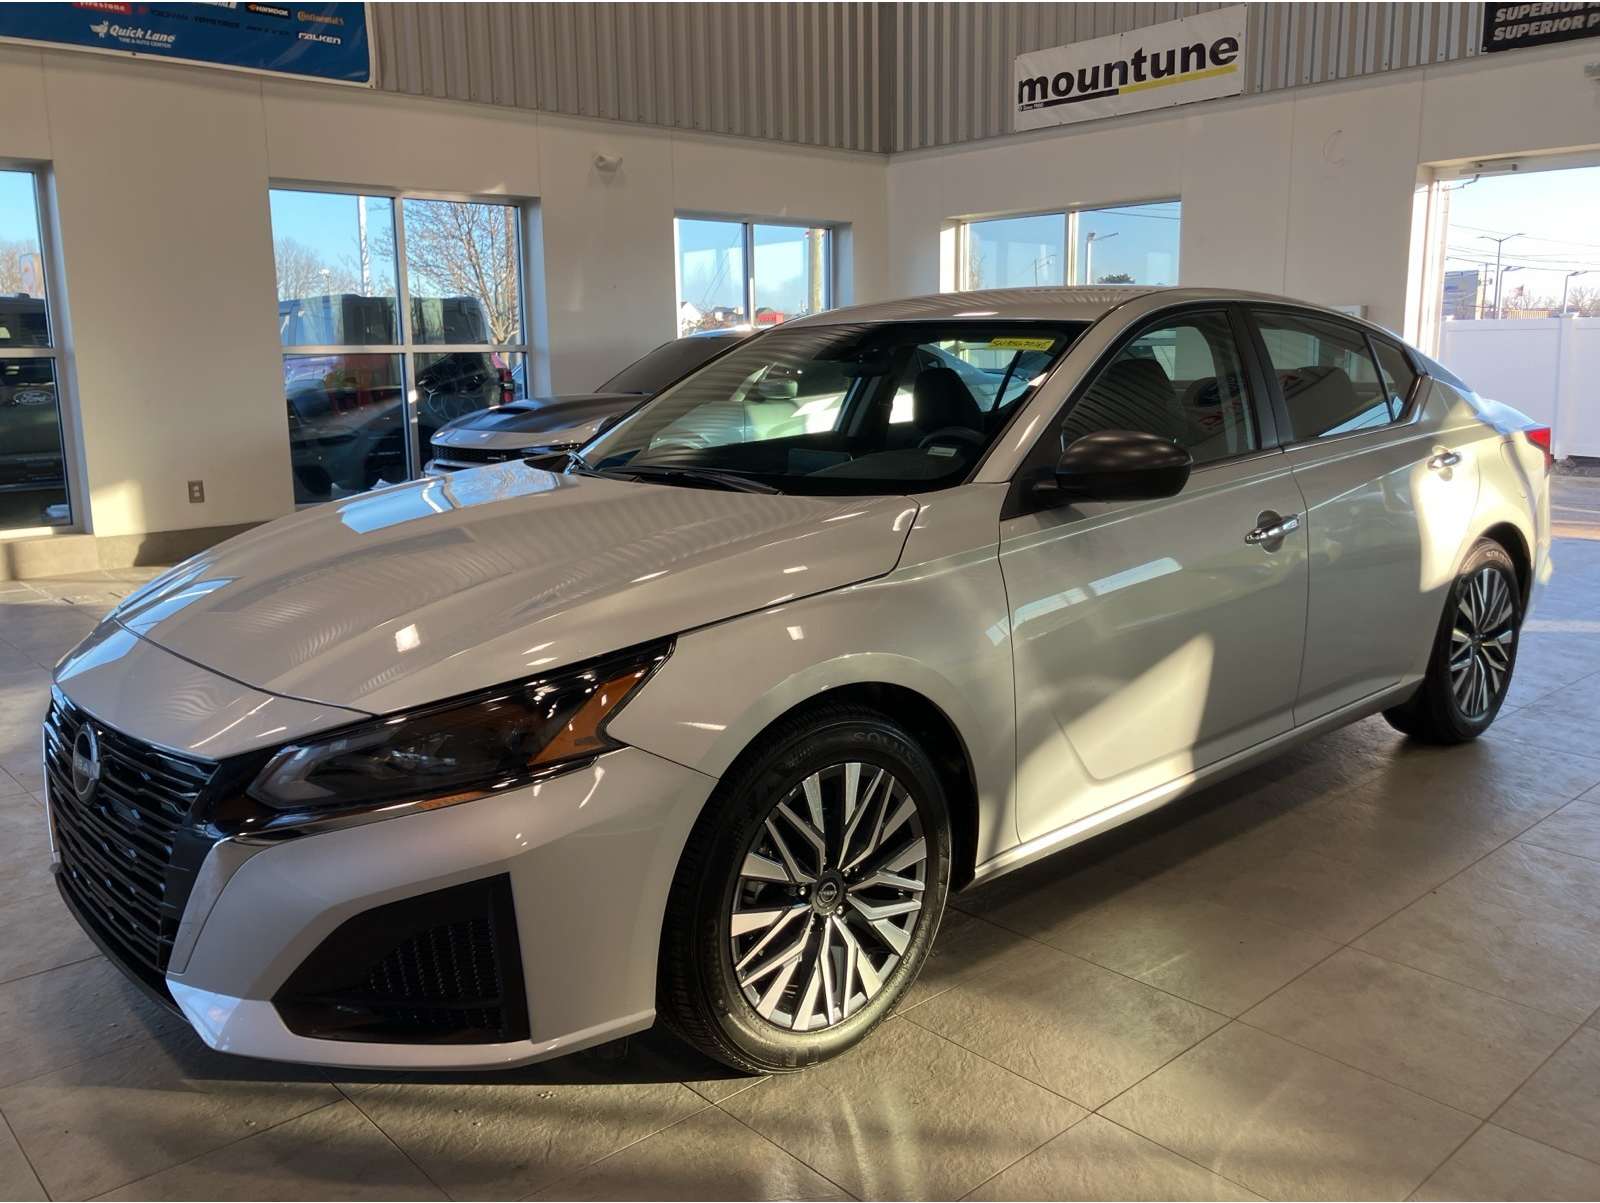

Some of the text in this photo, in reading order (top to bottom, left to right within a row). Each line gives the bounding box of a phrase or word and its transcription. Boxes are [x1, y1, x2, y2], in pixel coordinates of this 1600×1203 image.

[1495, 2, 1585, 22] SUPERIOR
[109, 25, 175, 43] Quick Lane
[1493, 15, 1585, 41] SUPERIOR
[298, 32, 341, 45] FALKEN
[1016, 36, 1239, 104] mountune
